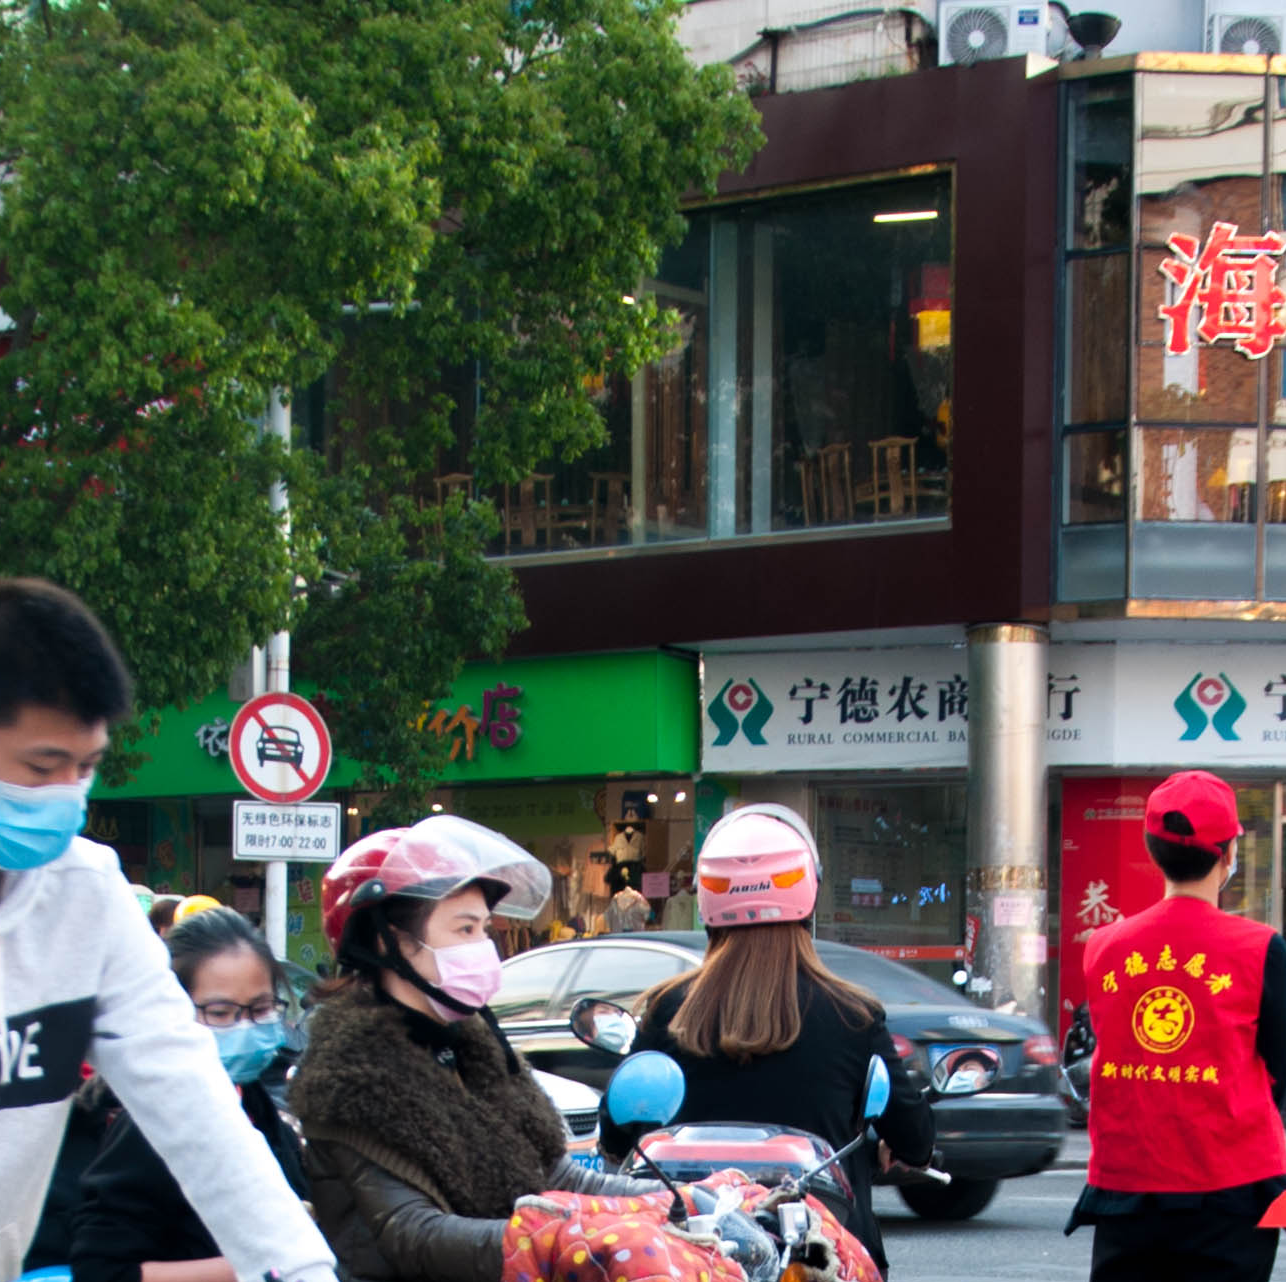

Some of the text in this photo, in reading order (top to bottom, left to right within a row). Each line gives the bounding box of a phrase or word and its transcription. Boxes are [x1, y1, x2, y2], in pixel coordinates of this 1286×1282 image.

[788, 673, 1082, 726] 宁德农商行
[786, 733, 835, 745] RURAL
[842, 730, 939, 744] COMMERCIAL
[241, 812, 333, 828] 无绿色环保标志
[1100, 1061, 1220, 1085] 新时代文明实践
